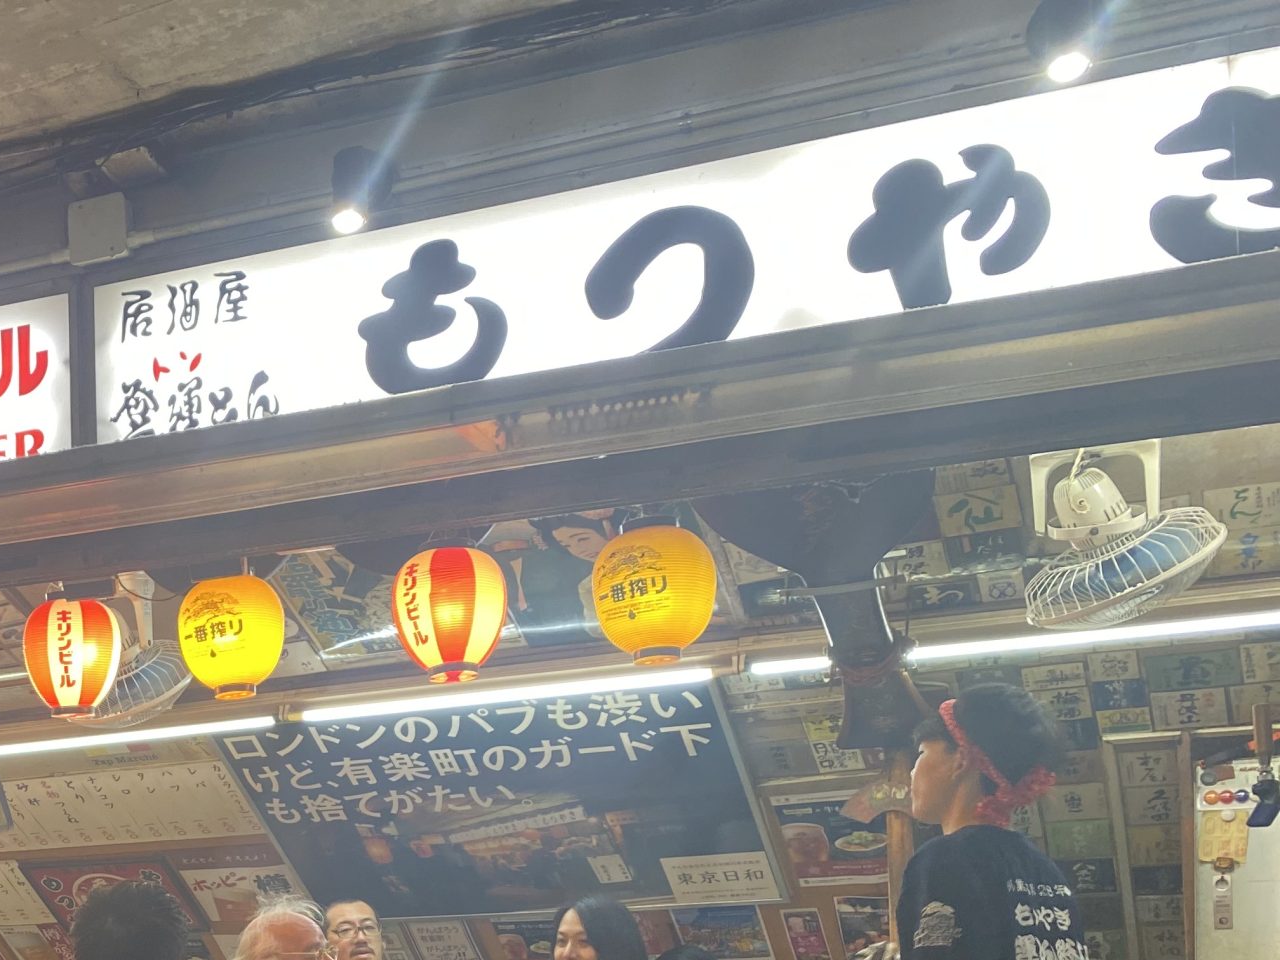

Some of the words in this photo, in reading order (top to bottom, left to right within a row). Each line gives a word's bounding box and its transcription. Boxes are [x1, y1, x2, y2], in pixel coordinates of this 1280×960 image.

[358, 86, 1280, 394] もつやき
[121, 271, 249, 343] 居酒屋
[403, 563, 429, 647] キリンビール
[598, 575, 668, 603] 一番搾り
[56, 610, 76, 688] キリンビール
[184, 618, 244, 644] 一番搾り
[222, 688, 704, 761] ロンドンのパブも渋い
[242, 722, 712, 795] けど、有楽町のガード下
[264, 784, 534, 824] も捨てがたい。
[191, 871, 248, 892] ホッピー
[676, 868, 764, 885] 東京日和
